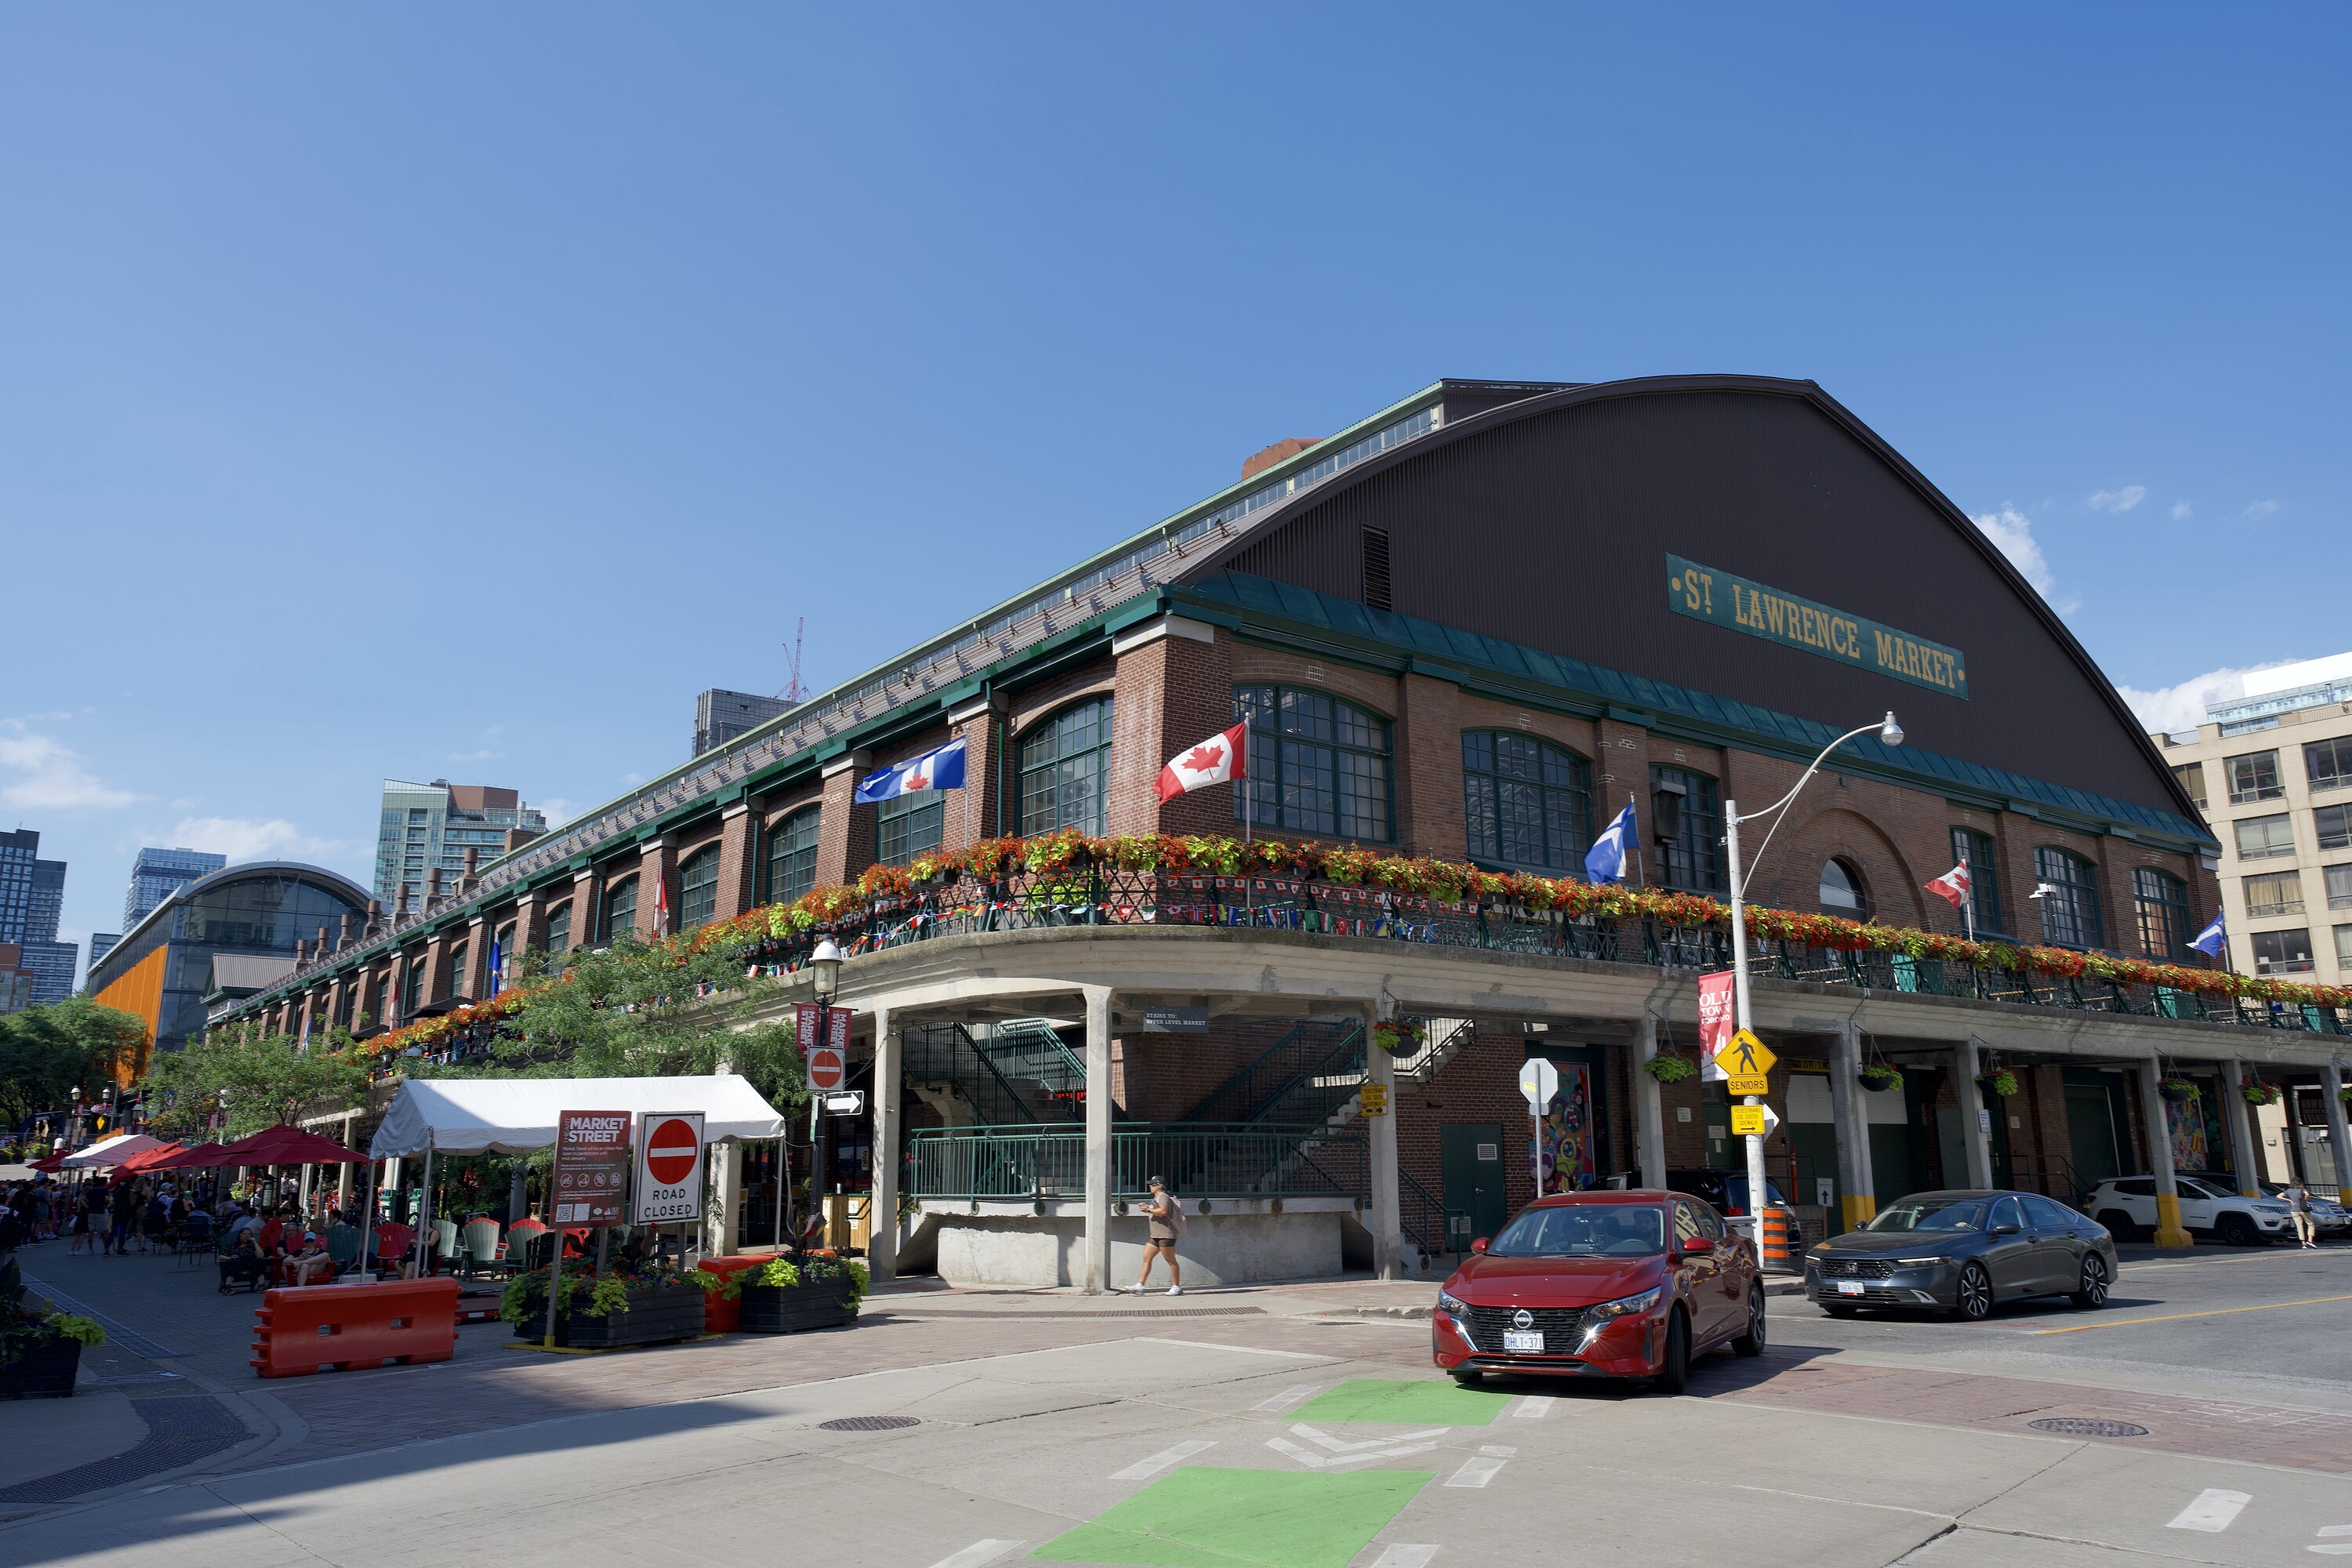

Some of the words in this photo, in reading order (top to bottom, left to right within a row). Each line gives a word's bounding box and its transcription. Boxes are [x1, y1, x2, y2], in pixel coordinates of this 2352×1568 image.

[1733, 584, 1860, 659] LAWRENCE
[1875, 630, 1955, 689] MARKET
[1699, 990, 1731, 1007] OLD
[1700, 1004, 1731, 1016] TOWN
[800, 1010, 808, 1046] STREET
[830, 1013, 840, 1047] STREET
[837, 1014, 847, 1048] MARKE
[1730, 1080, 1765, 1091] SENIORS
[569, 1116, 626, 1130] MARKET
[568, 1130, 620, 1143] STREET
[652, 1189, 686, 1200] ROAD
[644, 1204, 692, 1218] CLOSED
